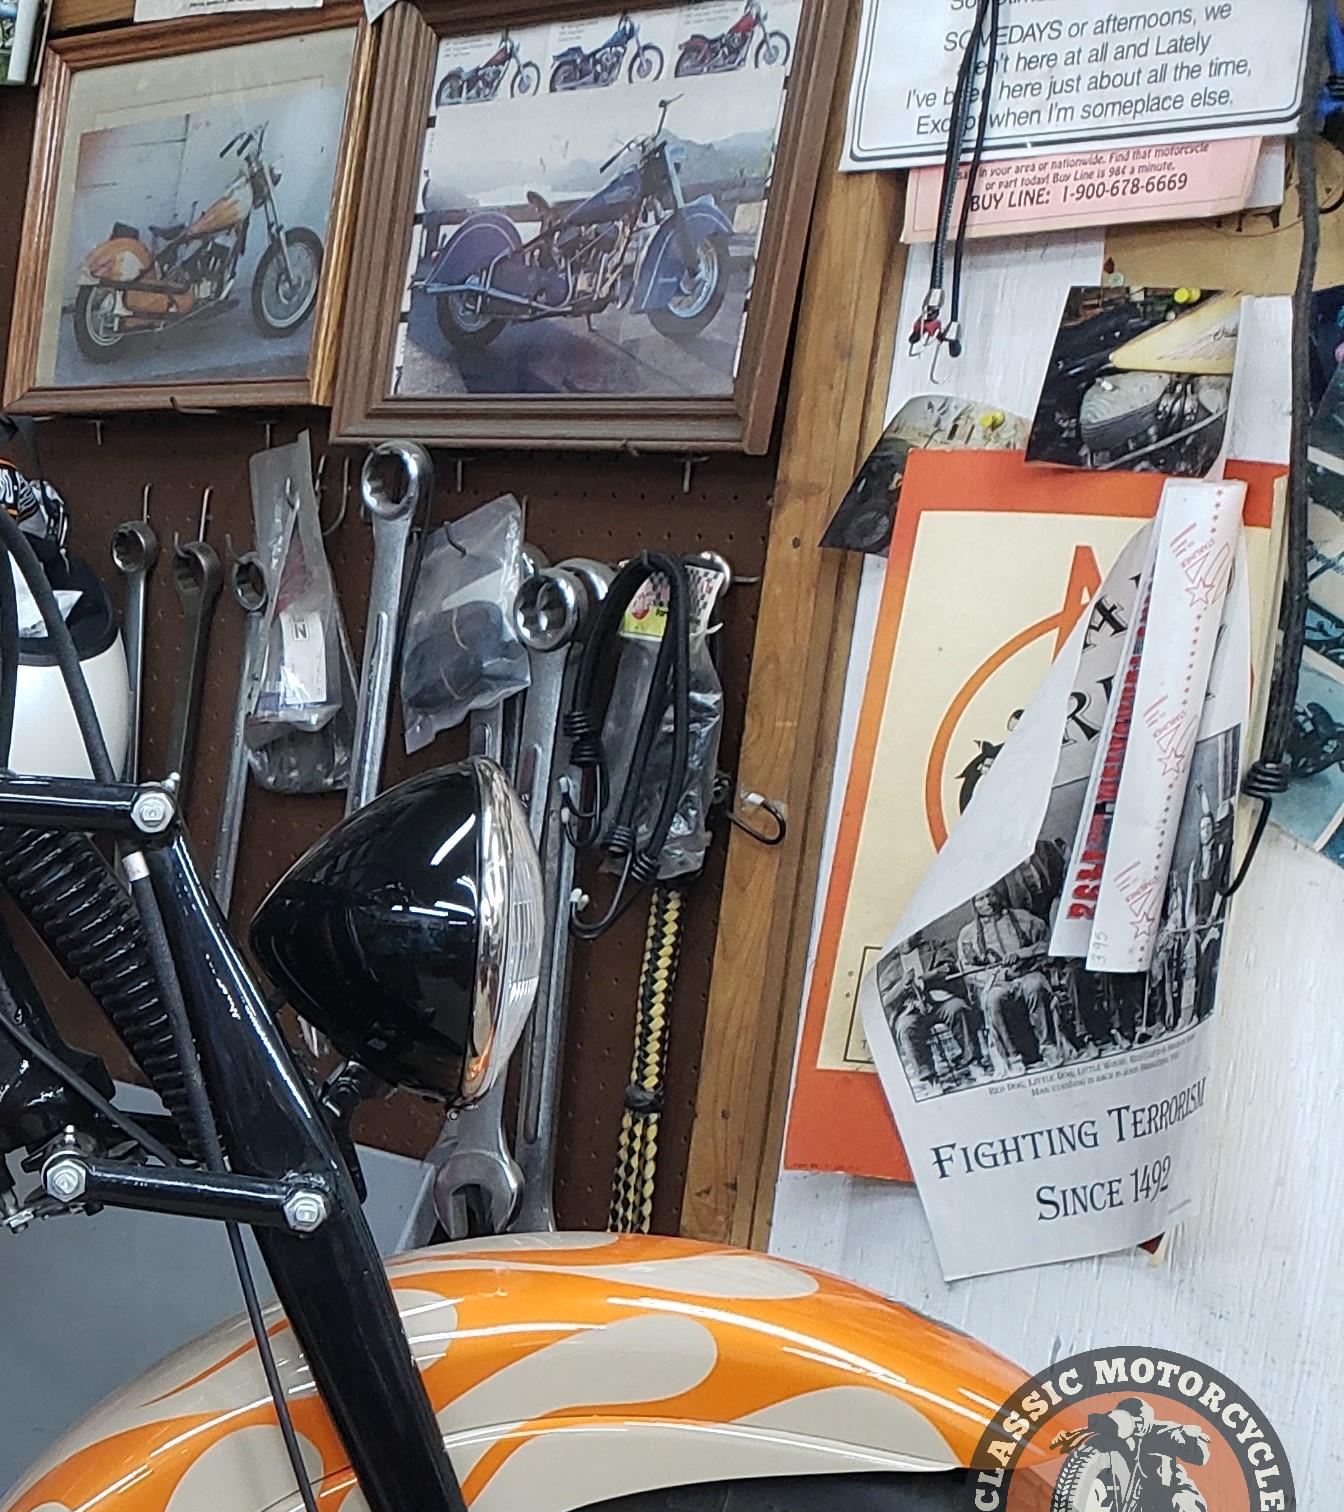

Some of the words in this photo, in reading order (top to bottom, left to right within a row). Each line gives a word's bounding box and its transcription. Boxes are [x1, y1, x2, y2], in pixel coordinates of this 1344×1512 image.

[1068, 21, 1088, 38] or
[1093, 8, 1196, 35] afternoons,
[1205, 3, 1232, 21] we
[1016, 51, 1058, 72] here
[1064, 46, 1082, 63] at
[1088, 42, 1108, 63] all
[1113, 36, 1149, 61] and
[1155, 31, 1212, 56] Lately
[906, 88, 936, 109] I've
[999, 79, 1042, 100] here
[1046, 75, 1082, 100] just
[1087, 67, 1142, 92] about
[1147, 63, 1167, 85] all
[1173, 60, 1201, 82] the
[1208, 57, 1252, 77] time,
[990, 107, 1040, 128] when
[1047, 103, 1074, 122] I'm
[1080, 92, 1184, 120] someplace
[1190, 87, 1233, 107] else.
[989, 165, 1011, 178] your
[1014, 162, 1036, 174] area
[1109, 150, 1130, 163] Find
[1052, 172, 1072, 184] Buy
[1073, 168, 1095, 182] Line
[1097, 168, 1106, 179] is
[970, 192, 1004, 212] BUY
[1007, 187, 1051, 208] LINE:
[1062, 172, 1188, 203] 1-900-678-6669
[1130, 1155, 1172, 1203] 1492
